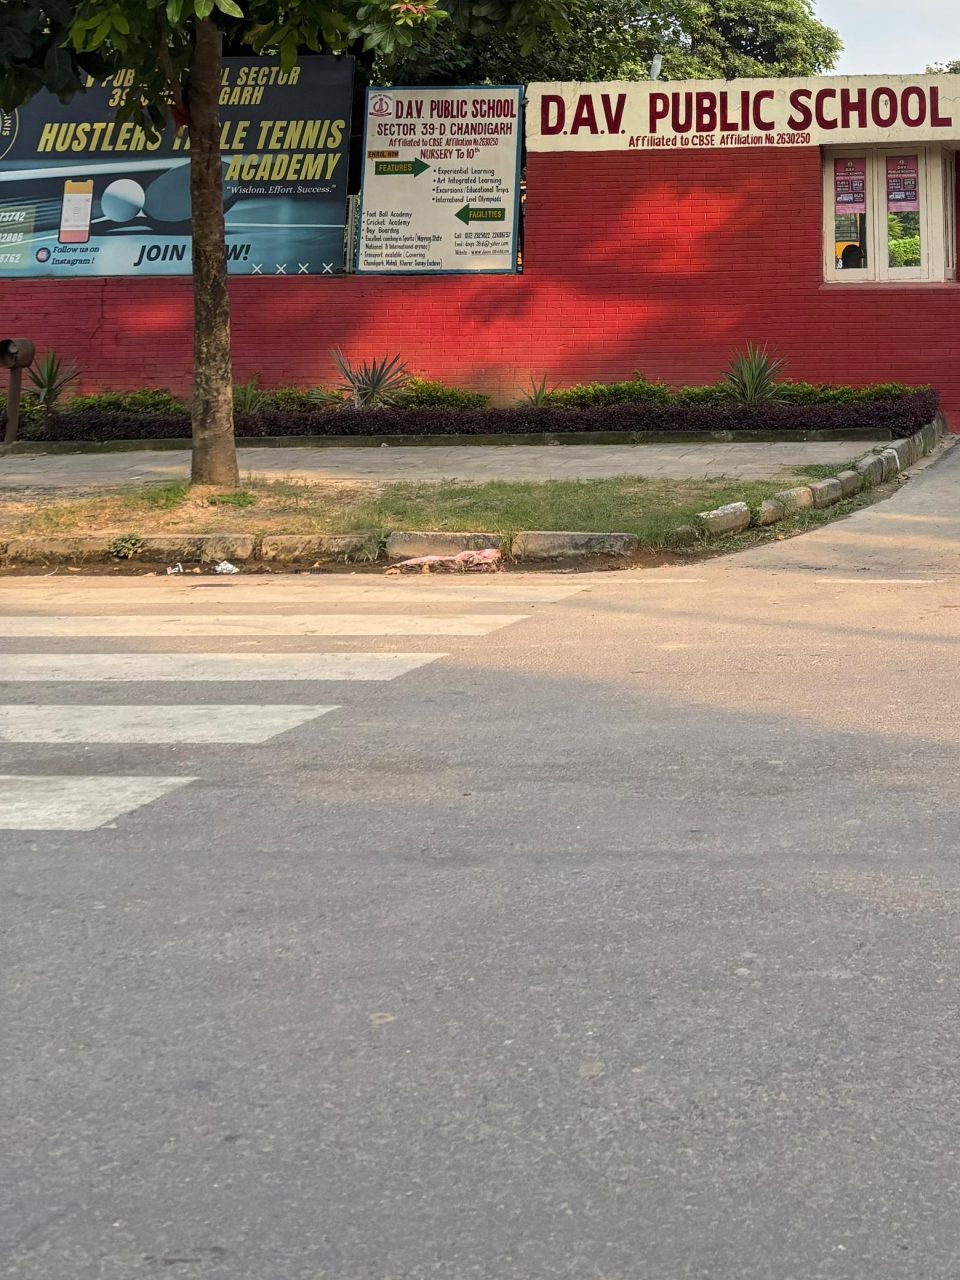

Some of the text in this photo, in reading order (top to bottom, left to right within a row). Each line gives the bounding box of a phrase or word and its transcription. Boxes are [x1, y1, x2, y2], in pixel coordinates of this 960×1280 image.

[395, 98, 516, 119] D.A.V. PUBLIC SCHOOL
[541, 85, 953, 136] D.A.V. PUBLIC SCHOOL
[376, 122, 416, 136] SECTOR
[450, 122, 512, 136] CHANDIGARH
[256, 119, 346, 150] TENNIS
[389, 137, 421, 147] Affiliated
[421, 138, 428, 146] to
[428, 137, 442, 146] CBSE
[444, 137, 473, 147] Affiliation
[628, 135, 677, 148] Affiliated
[680, 135, 690, 147] to
[691, 134, 716, 147] CBSE
[719, 133, 763, 146] Affiliation
[776, 132, 811, 145] 2630250
[420, 147, 481, 160] NURSERY To 10th
[224, 153, 342, 181] ACADEMY
[379, 163, 413, 172] FEATURES
[437, 167, 495, 177] Experiential Learning
[448, 177, 477, 186] Integrated
[478, 176, 502, 186] Learning
[495, 186, 509, 195] Trips
[390, 210, 413, 219] Academy
[469, 210, 502, 218] FACILITIES
[388, 219, 411, 227] Academy
[52, 245, 79, 253] Follow
[132, 244, 187, 267] JOIN
